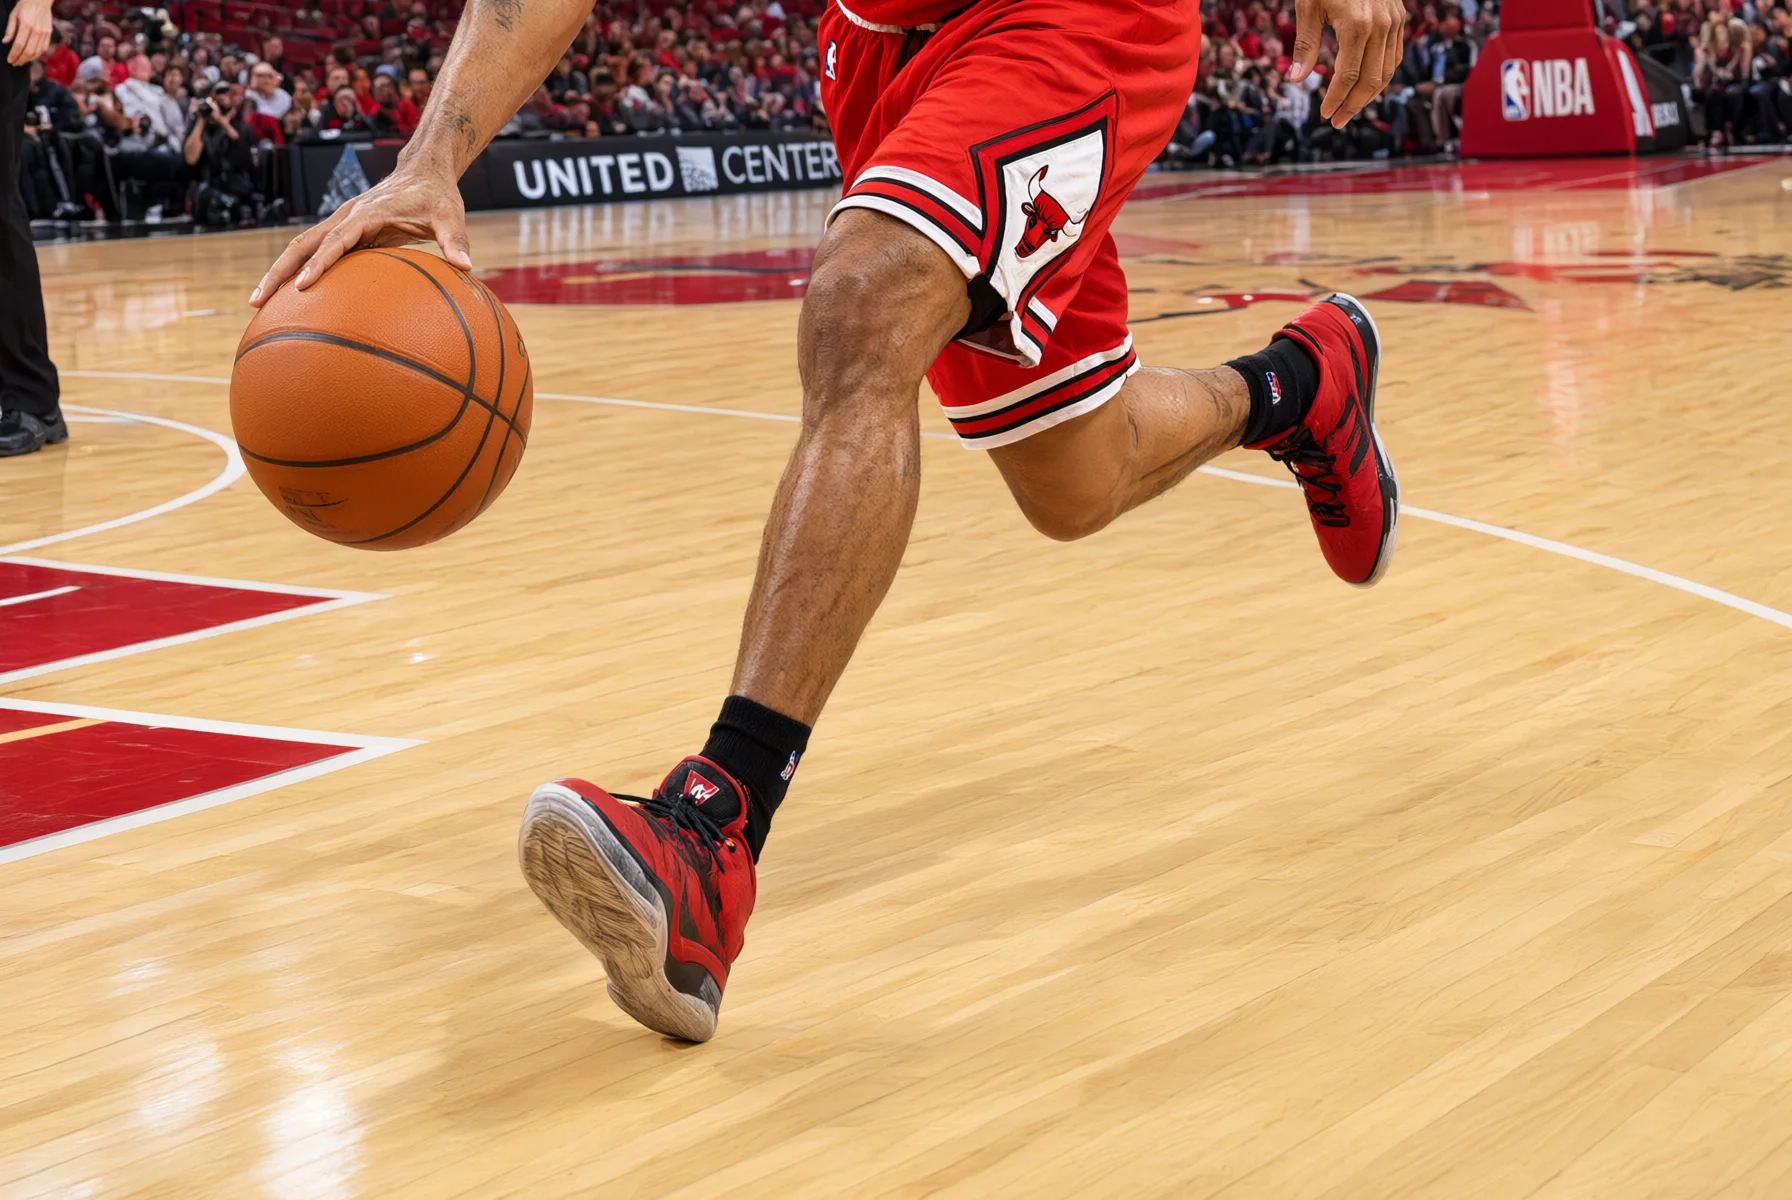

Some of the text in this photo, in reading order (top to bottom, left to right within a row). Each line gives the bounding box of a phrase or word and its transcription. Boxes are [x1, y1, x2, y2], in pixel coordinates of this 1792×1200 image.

[1532, 58, 1595, 118] NBA
[513, 141, 842, 200] UNITED CENTER
